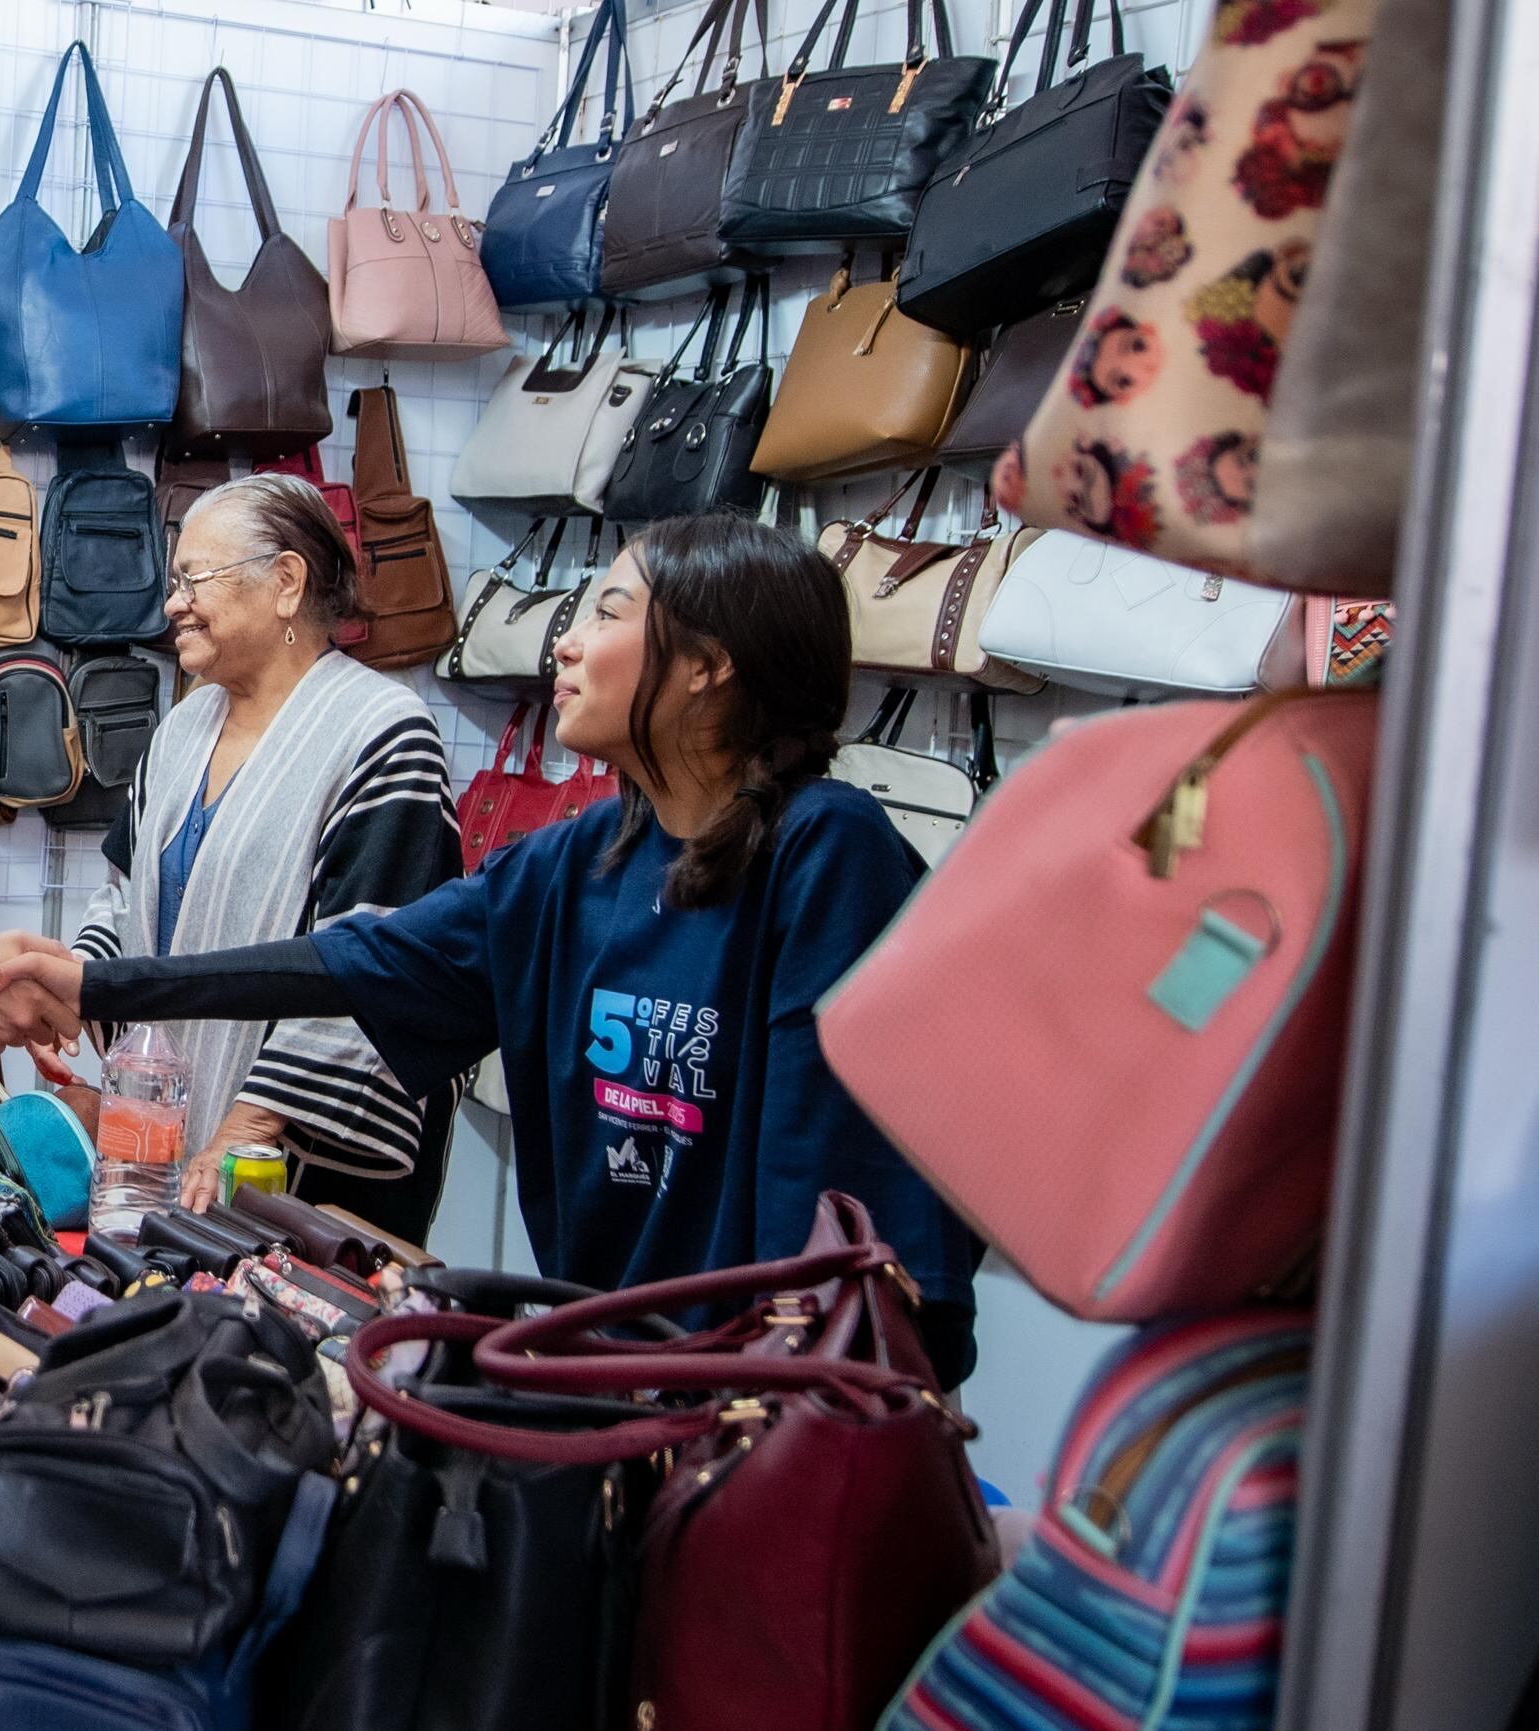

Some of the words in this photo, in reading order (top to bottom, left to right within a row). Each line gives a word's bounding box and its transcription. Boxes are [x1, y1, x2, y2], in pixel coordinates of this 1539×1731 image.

[652, 999, 719, 1037] FES
[643, 1058, 717, 1099] VAL
[604, 1087, 619, 1106] DE
[620, 1091, 631, 1109] LA
[630, 1097, 665, 1116] PIEL
